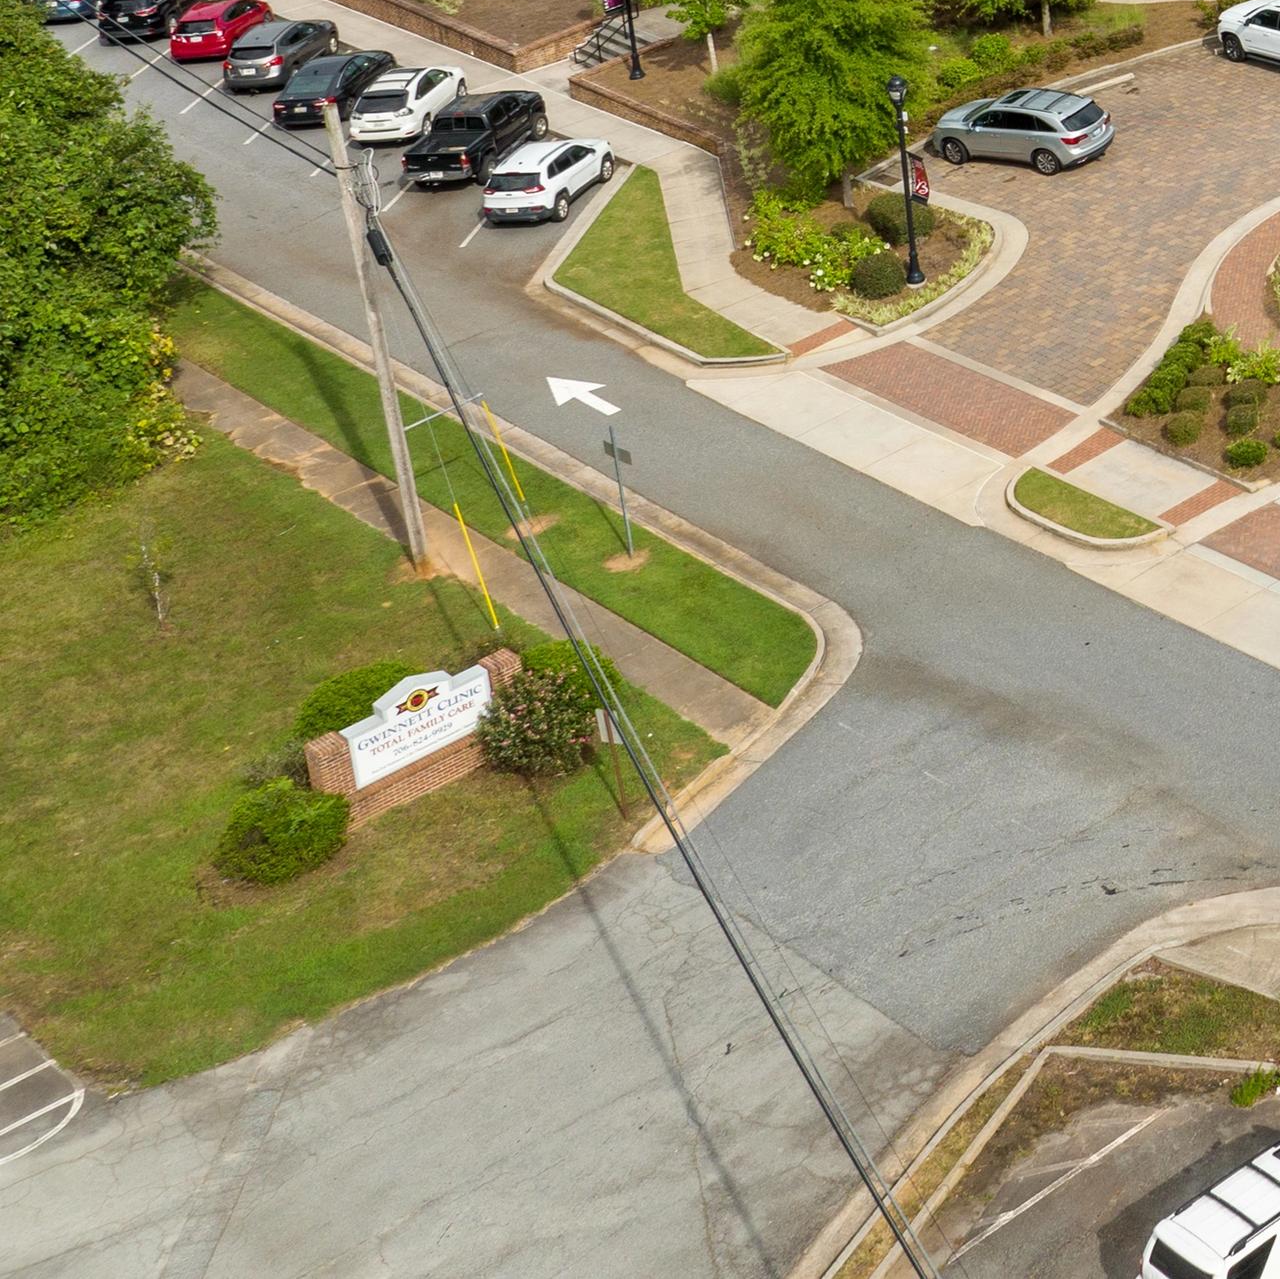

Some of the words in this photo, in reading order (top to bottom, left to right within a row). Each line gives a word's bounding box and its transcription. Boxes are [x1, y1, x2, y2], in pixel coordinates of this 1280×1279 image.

[357, 706, 435, 751] GWINNETT
[437, 684, 482, 711] CLINIC
[369, 735, 406, 756] TOTAL
[407, 713, 447, 738] FAMILY
[447, 700, 475, 718] CARE
